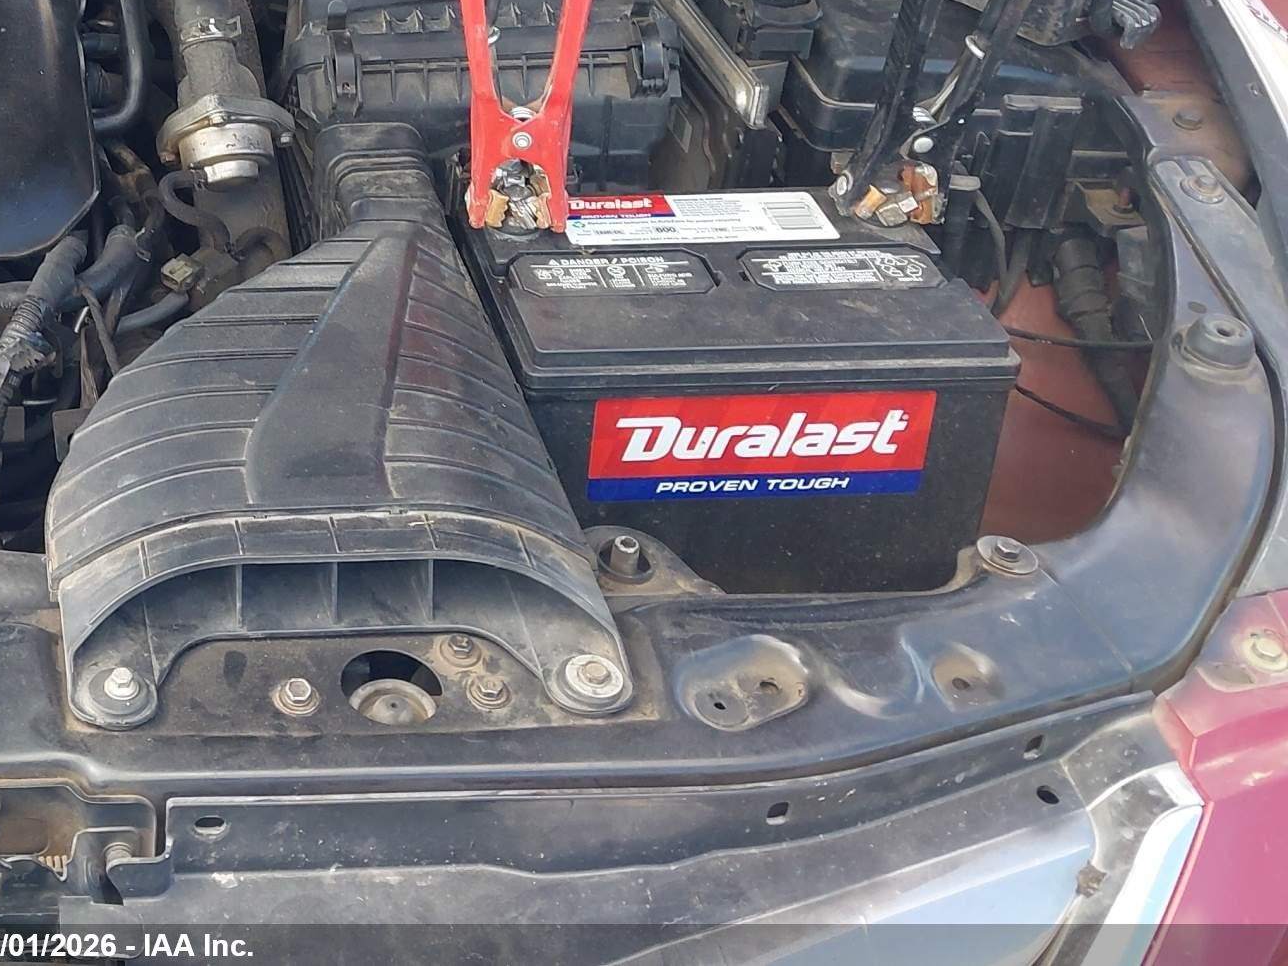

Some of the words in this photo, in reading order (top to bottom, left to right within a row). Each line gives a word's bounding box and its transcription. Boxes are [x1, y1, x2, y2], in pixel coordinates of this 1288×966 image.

[568, 197, 653, 211] Duralast
[560, 257, 609, 266] DANGER
[621, 256, 665, 265] POISON
[615, 409, 908, 463] Duralast
[655, 479, 757, 494] PROVEN
[766, 476, 850, 492] TOUGH
